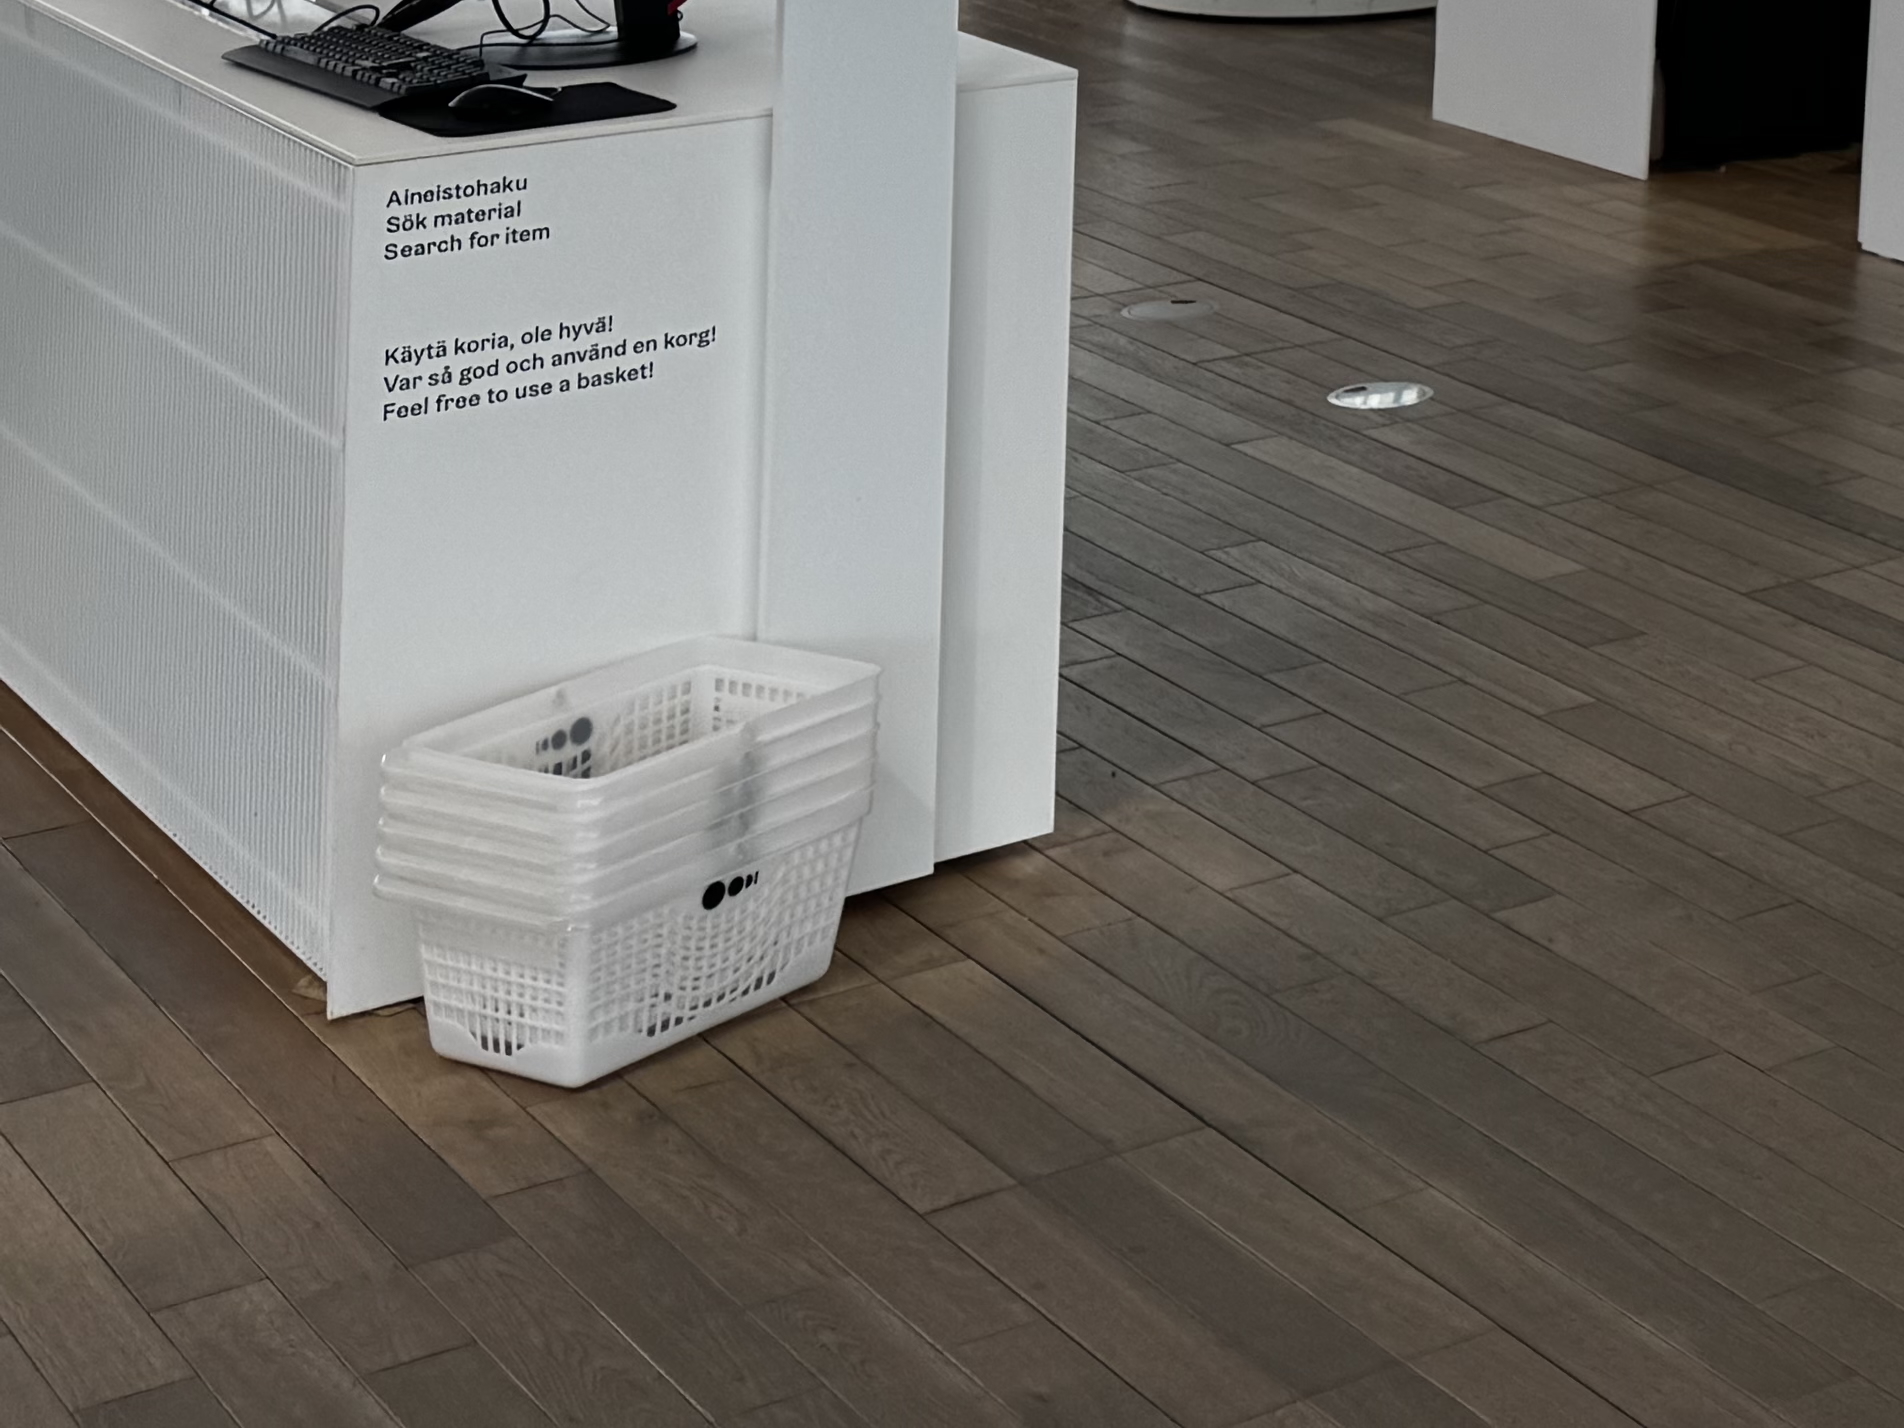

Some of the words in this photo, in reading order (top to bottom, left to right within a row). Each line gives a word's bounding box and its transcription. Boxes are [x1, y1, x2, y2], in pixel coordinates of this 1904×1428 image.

[386, 175, 527, 208] Aineistohaku
[386, 213, 427, 234] Sök
[433, 201, 522, 227] material
[384, 235, 461, 261] Search
[469, 230, 499, 248] for
[505, 224, 550, 244] item
[383, 373, 423, 394] Var
[428, 366, 452, 386] så
[458, 358, 499, 386] god
[506, 353, 544, 375] och
[551, 339, 627, 368] använd
[633, 337, 658, 354] en
[663, 326, 717, 351] korg!
[385, 340, 447, 369] Käytä
[454, 331, 515, 357] koria,
[521, 325, 552, 346] ole
[558, 315, 613, 341] hyvä!
[382, 398, 428, 421] Feel
[435, 393, 481, 413] free
[487, 387, 507, 404] to
[515, 382, 553, 400] use
[559, 378, 571, 392] a
[577, 362, 654, 390] basket!
